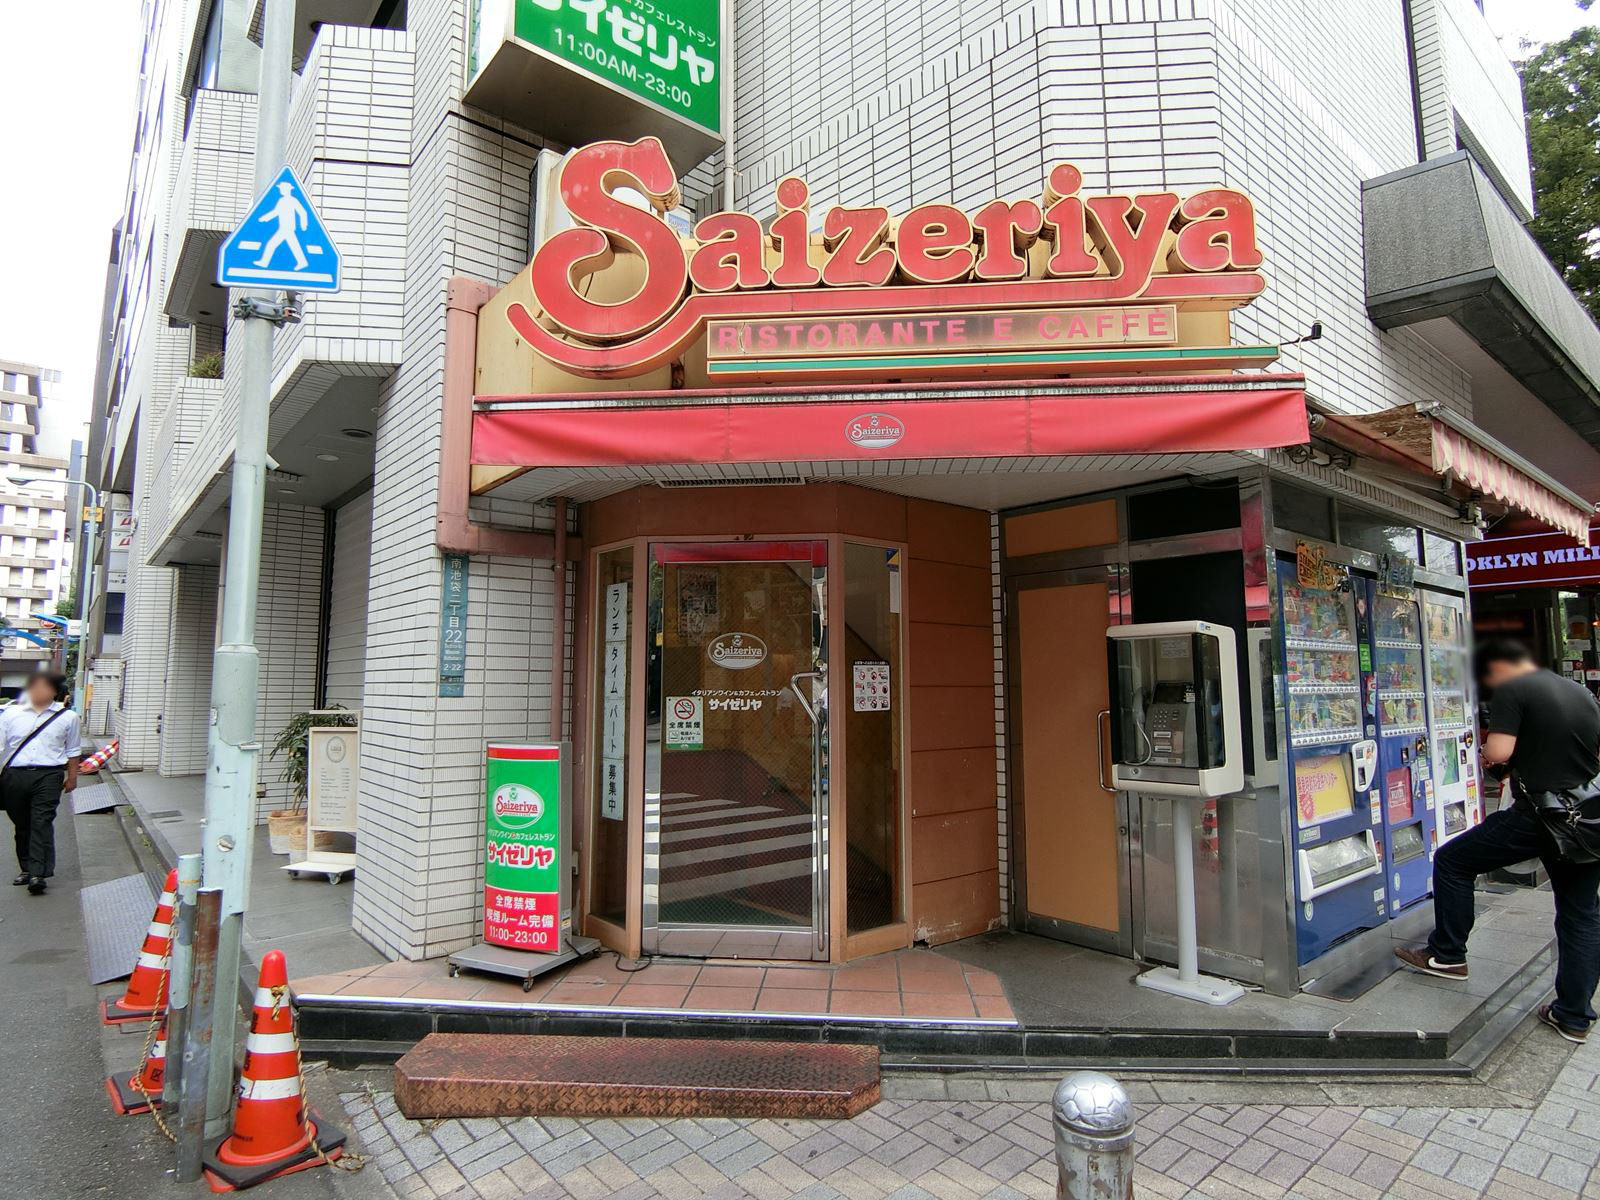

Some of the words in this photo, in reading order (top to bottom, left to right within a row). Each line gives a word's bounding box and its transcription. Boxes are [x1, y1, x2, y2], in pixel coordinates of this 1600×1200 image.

[625, 0, 716, 48] カフェレストラン
[531, 0, 715, 87] イゼリヤ
[554, 27, 692, 108] 11:00AM-23:00
[507, 137, 1266, 376] Saizeriya
[718, 319, 966, 351] RISTORANTE
[993, 317, 1013, 341] E
[851, 423, 900, 441] Saizeriya
[1466, 552, 1538, 572] OKLYN
[444, 629, 463, 643] 22
[713, 642, 763, 661] Saizeriya
[708, 698, 763, 711] サイゼリヤ
[495, 795, 538, 816] Saizeriya
[488, 840, 556, 869] サイゼリヤ
[495, 894, 537, 911] 全席禁煙
[486, 908, 554, 929] 喫煙ルーム完備
[489, 925, 548, 944] 11:00-23:00
